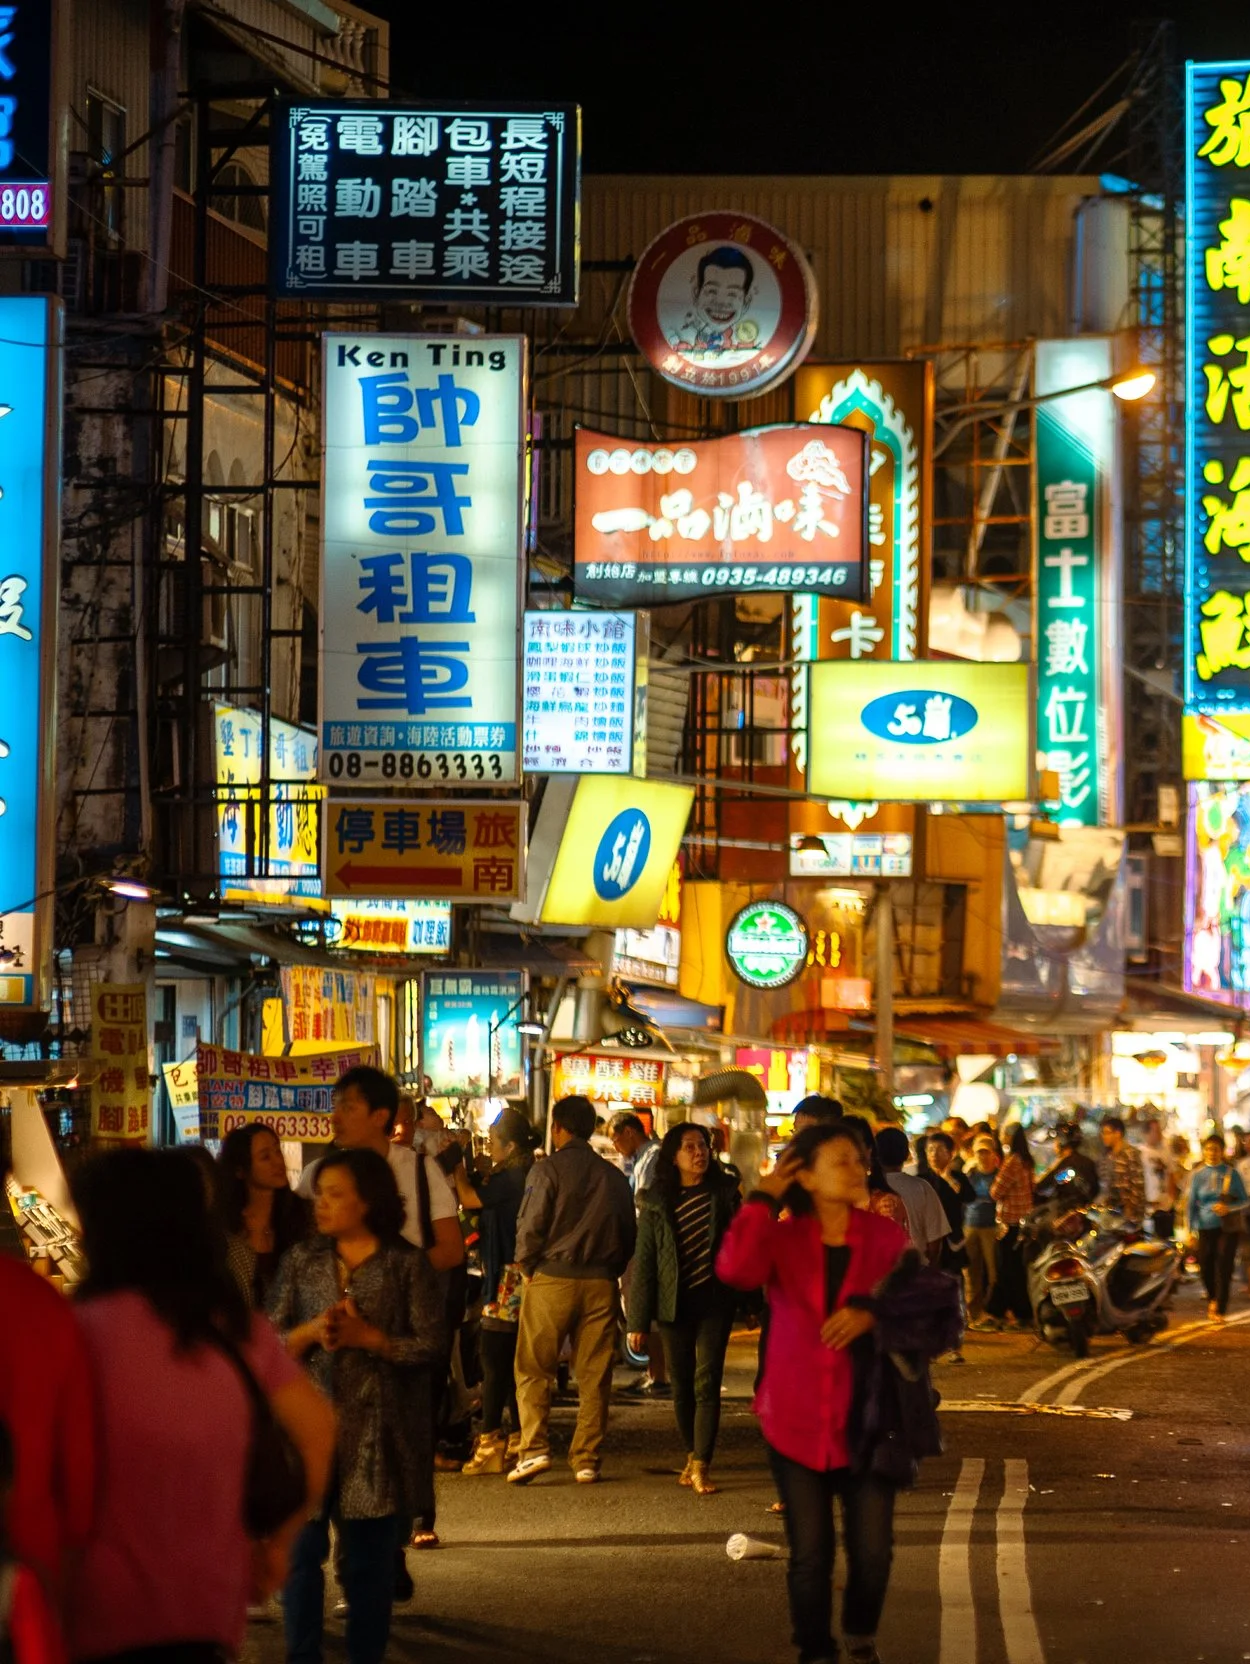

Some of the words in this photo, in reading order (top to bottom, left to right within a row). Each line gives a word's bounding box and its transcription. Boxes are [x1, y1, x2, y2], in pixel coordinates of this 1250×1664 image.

[333, 116, 383, 281] 電動車
[390, 116, 439, 280] 腳踏車
[498, 119, 549, 285] 長短程接送
[337, 345, 408, 368] Ken
[427, 344, 506, 371] Ting
[356, 372, 480, 716] 帥哥租車
[701, 566, 848, 586] 0935-489346
[1043, 480, 1090, 829] 富士數位影
[328, 751, 503, 780] 08-8863333
[335, 808, 466, 855] 停車場
[473, 812, 517, 892] 旅南
